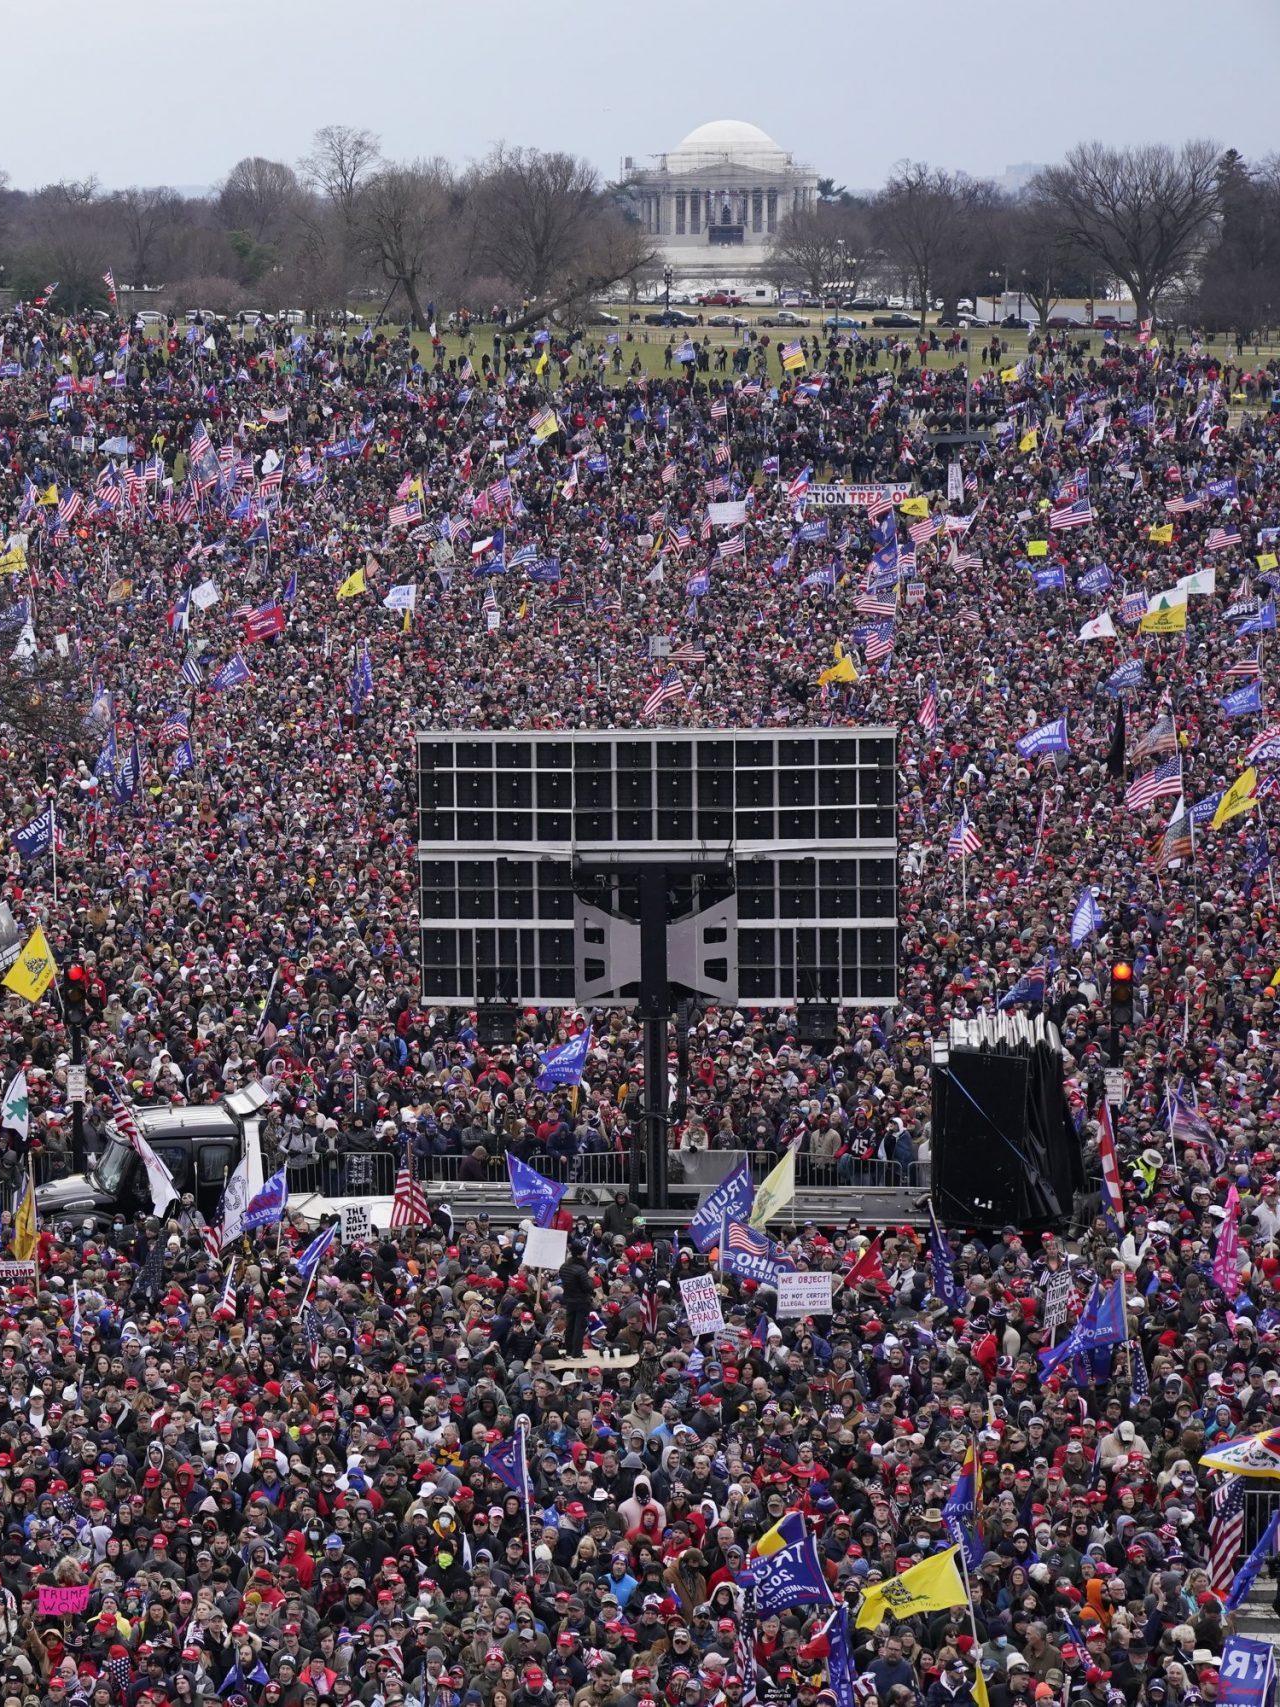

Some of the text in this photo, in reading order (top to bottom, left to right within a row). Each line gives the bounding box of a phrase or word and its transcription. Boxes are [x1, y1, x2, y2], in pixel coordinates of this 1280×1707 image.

[851, 1138, 867, 1154] 45
[346, 1207, 364, 1216] THE
[346, 1215, 367, 1225] SALT
[346, 1223, 368, 1233] MUST
[736, 1252, 787, 1275] OHIO
[731, 1262, 778, 1283] FOR TRUM
[780, 1276, 793, 1285] WE
[798, 1275, 831, 1285] OBJECT!
[1049, 1271, 1070, 1288] KEEP
[682, 1277, 713, 1293] GEORGIA
[1048, 1284, 1069, 1302] TRUMP
[683, 1287, 716, 1303] VOTER
[688, 1298, 718, 1315] AGAINST
[692, 1311, 720, 1324] FRAUD
[40, 1588, 87, 1601] TRUMP
[42, 1597, 88, 1614] WON!
